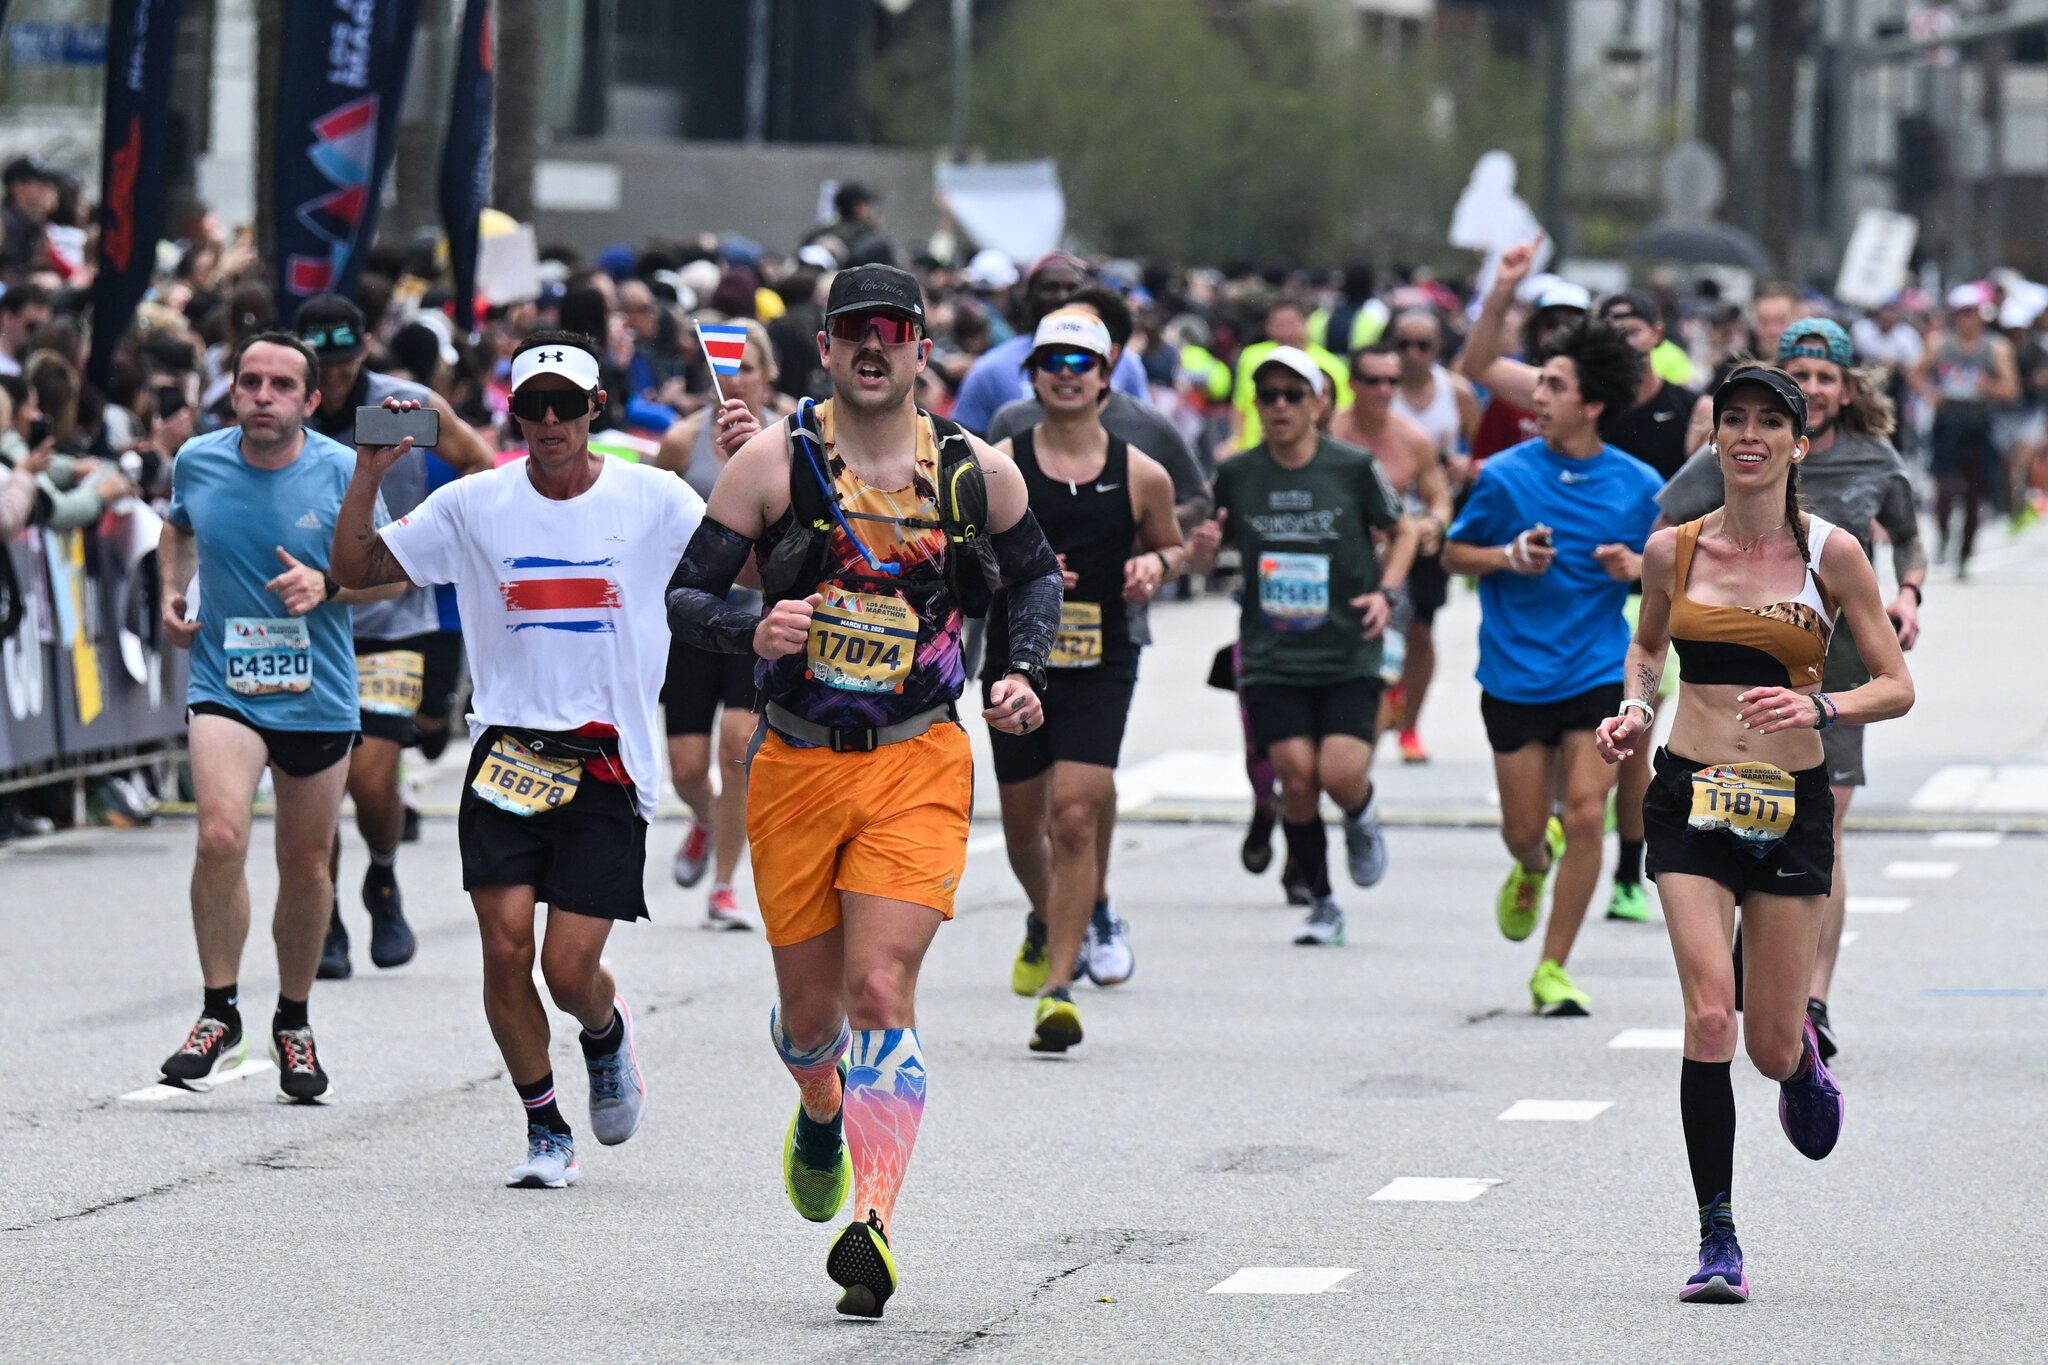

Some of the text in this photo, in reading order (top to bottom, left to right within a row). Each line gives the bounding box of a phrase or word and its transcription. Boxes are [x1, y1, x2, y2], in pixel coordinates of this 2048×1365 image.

[865, 607, 906, 619] MARATHON
[879, 603, 907, 613] ANGELES
[840, 619, 861, 629] MARCH
[870, 625, 885, 634] 2023
[816, 630, 901, 671] 17074
[229, 654, 308, 677] C4320
[844, 675, 869, 688] asics
[489, 764, 564, 808] 16878
[1705, 788, 1779, 823] 11811
